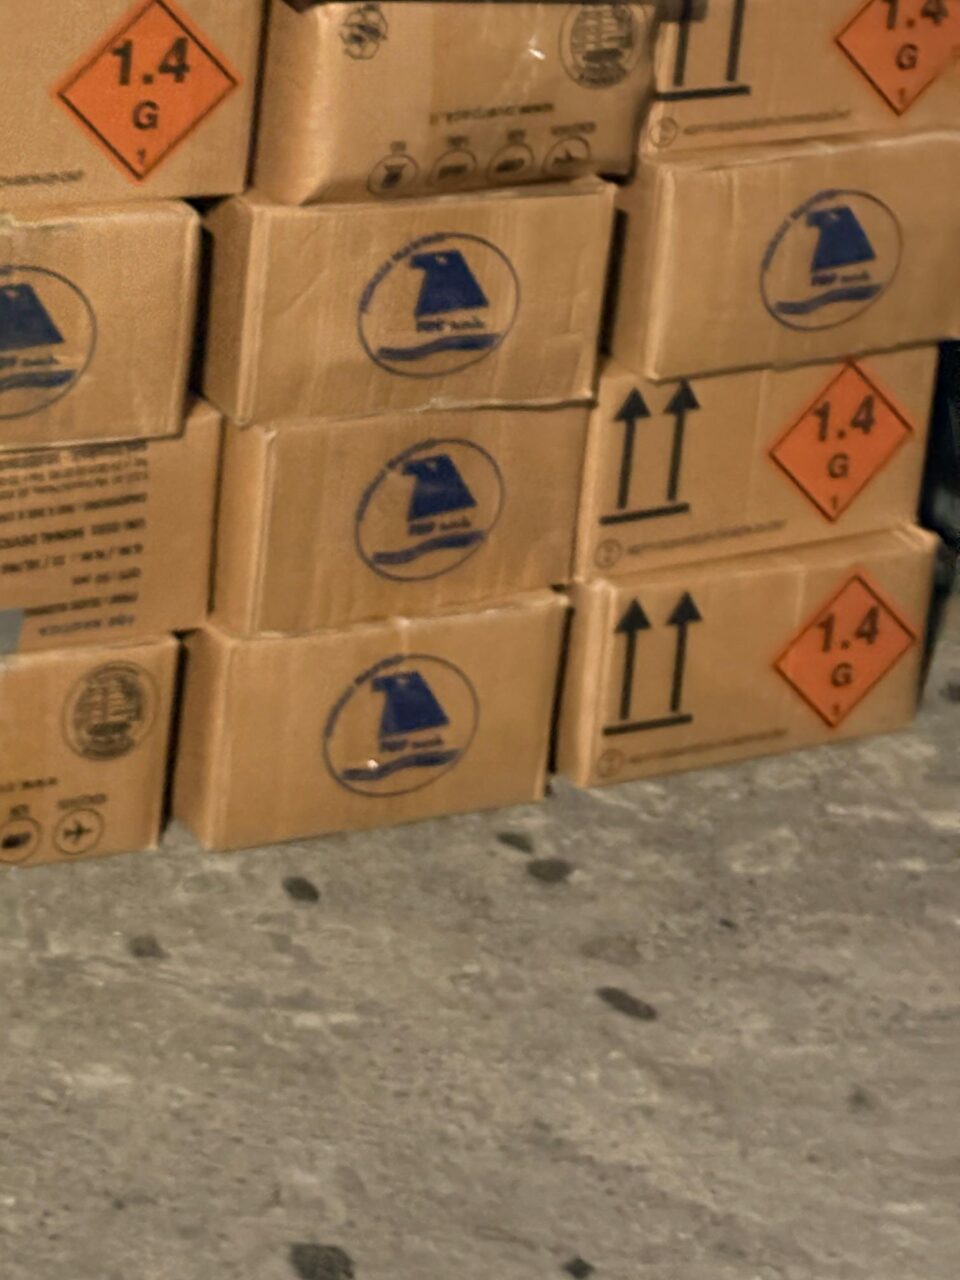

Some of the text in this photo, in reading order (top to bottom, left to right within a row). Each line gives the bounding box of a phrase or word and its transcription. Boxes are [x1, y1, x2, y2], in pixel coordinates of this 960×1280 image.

[112, 35, 190, 87] 1.4
[895, 44, 918, 70] G
[132, 100, 160, 130] G
[811, 394, 876, 442] 1.4
[827, 452, 850, 479] G
[816, 605, 881, 653] 1.4
[830, 662, 852, 687] G
